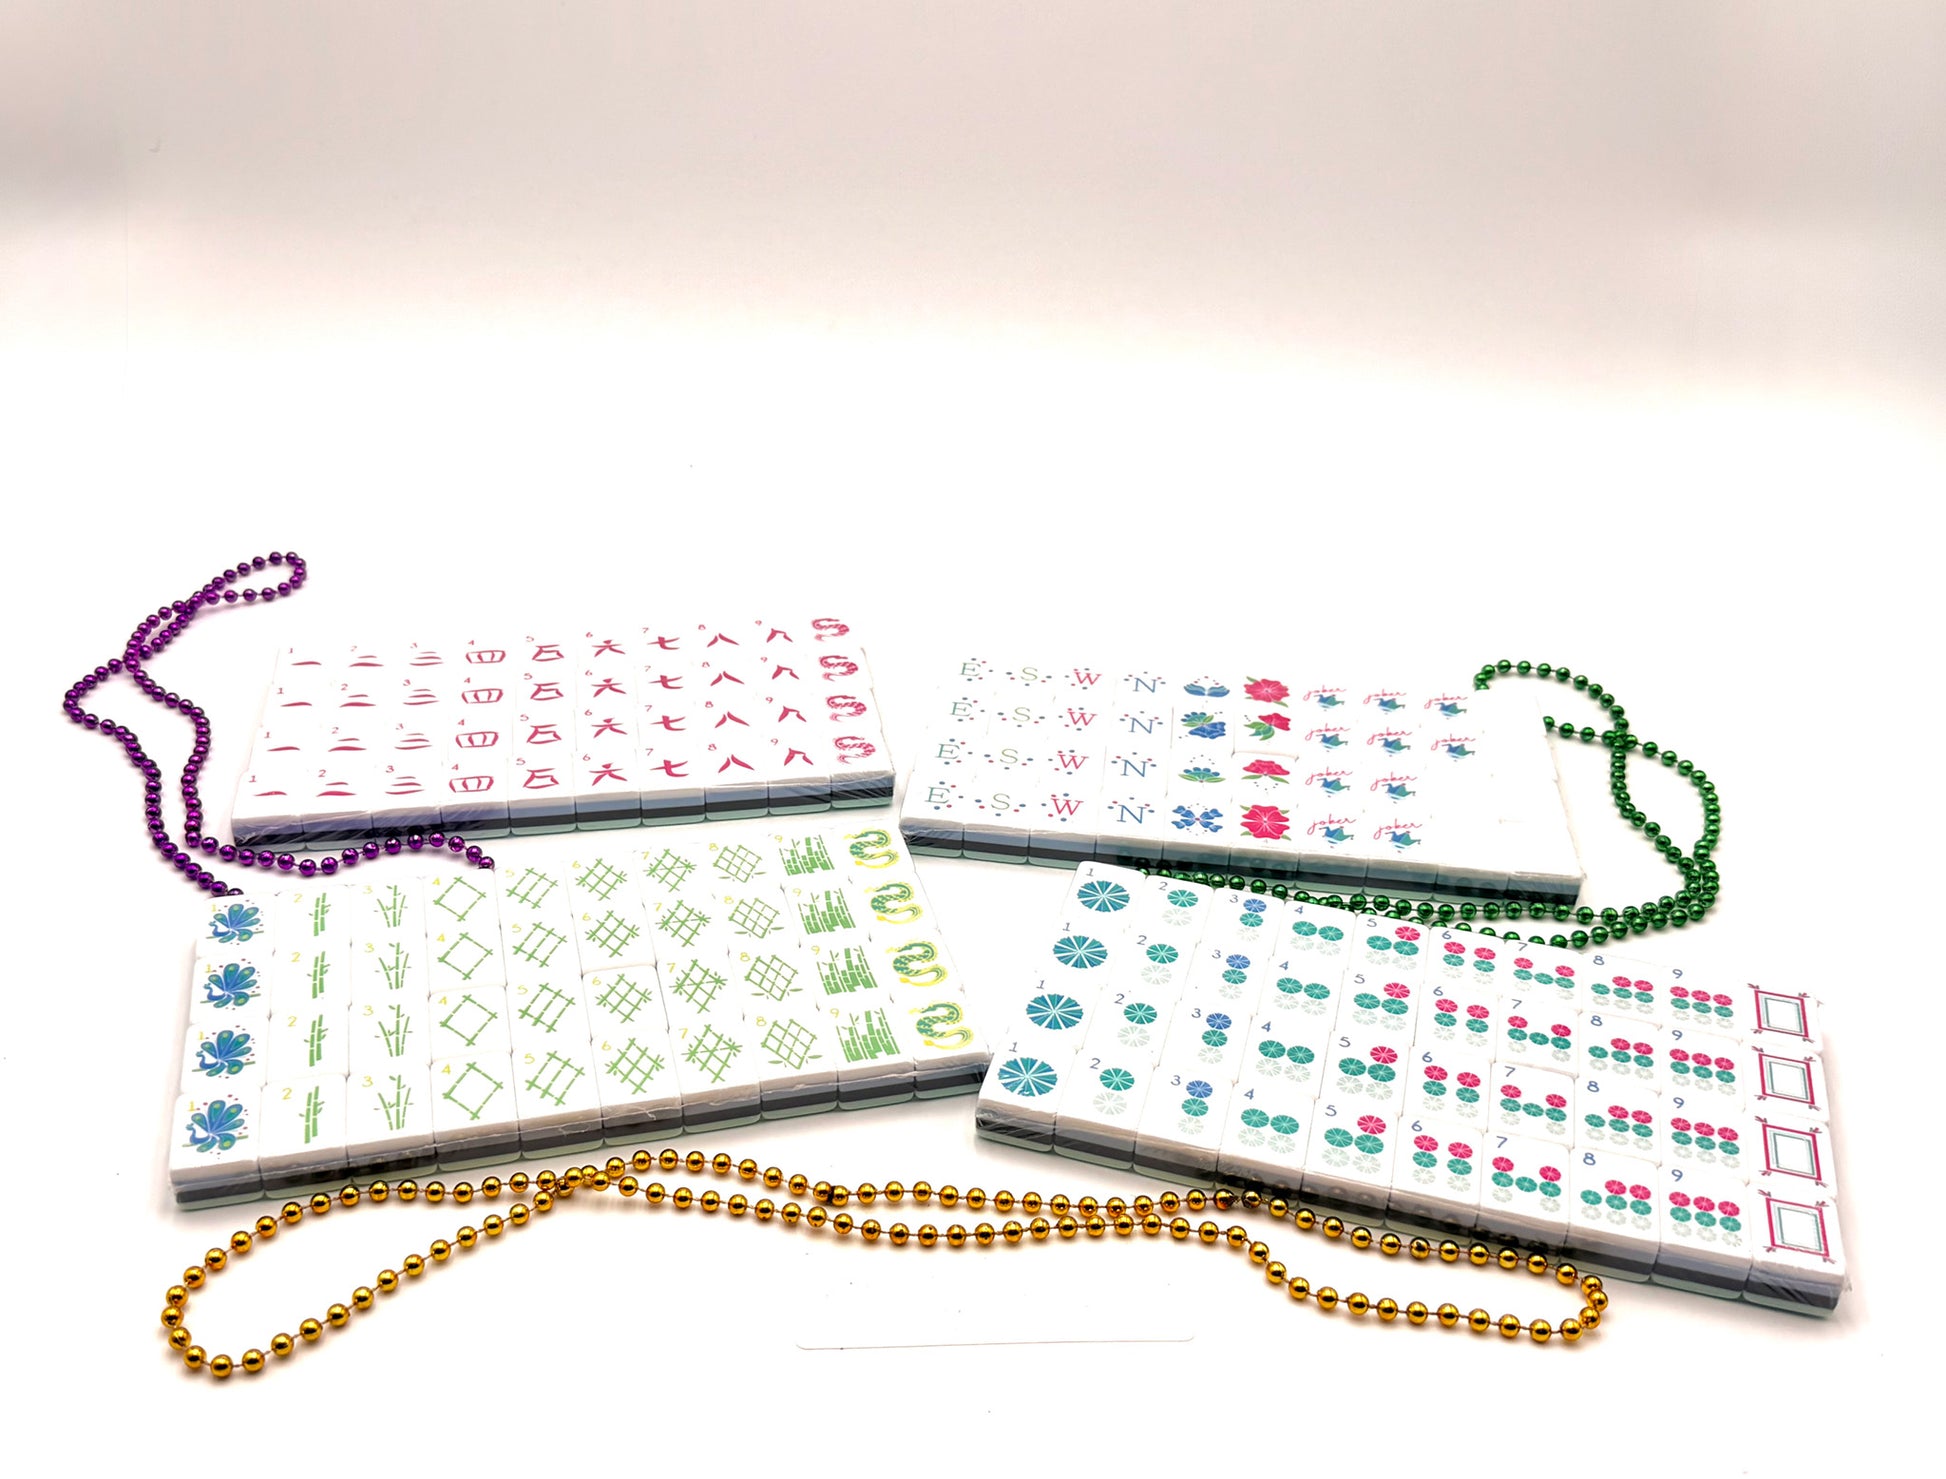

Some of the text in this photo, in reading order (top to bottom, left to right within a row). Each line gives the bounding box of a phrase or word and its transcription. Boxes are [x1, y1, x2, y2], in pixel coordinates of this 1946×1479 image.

[409, 651, 444, 666] 三
[960, 662, 982, 677] E
[1020, 666, 1038, 682] S
[1073, 670, 1102, 686] W
[1132, 677, 1158, 694] N
[403, 688, 439, 705] 三
[1302, 685, 1347, 701] joker
[1363, 689, 1406, 704] joker
[1424, 693, 1467, 709] joker
[950, 702, 974, 717] E
[1012, 706, 1032, 722] S
[1067, 712, 1098, 726] W
[1128, 717, 1156, 734] N
[1305, 723, 1350, 741] joker
[1366, 727, 1412, 744] joker
[394, 733, 432, 750] 三
[1430, 734, 1475, 751] joker
[936, 743, 962, 760] E
[1000, 748, 1018, 764] S
[1057, 754, 1089, 770] W
[1120, 759, 1149, 778] N
[1305, 767, 1352, 785] joker
[1370, 773, 1417, 791] joker
[385, 776, 425, 795] 三
[927, 786, 951, 804] E
[990, 793, 1010, 810] S
[1050, 798, 1084, 816] W
[1116, 804, 1147, 824] N
[1307, 814, 1356, 835] joker
[1373, 818, 1422, 840] joker
[1086, 868, 1093, 877] 1
[791, 887, 803, 897] 9
[1159, 882, 1168, 891] 2
[723, 895, 735, 905] 8
[1230, 895, 1238, 903] 3
[654, 901, 663, 913] 7
[1294, 906, 1303, 914] 4
[581, 912, 592, 922] 6
[1367, 919, 1377, 927] 5
[511, 922, 523, 934] 5
[1062, 923, 1070, 931] 1
[436, 933, 446, 943] 4
[1137, 935, 1147, 945] 2
[1442, 931, 1451, 939] 6
[364, 942, 375, 954] 3
[810, 944, 821, 956] 9
[1519, 942, 1527, 951] 7
[290, 951, 302, 964] 2
[739, 951, 752, 963] 8
[1212, 950, 1221, 959] 3
[1593, 955, 1604, 965] 8
[205, 964, 212, 973] 1
[666, 961, 677, 974] 7
[1279, 961, 1288, 970] 4
[1354, 974, 1365, 984] 5
[1672, 969, 1683, 979] 9
[591, 975, 602, 986] 6
[1036, 980, 1044, 989] 1
[516, 984, 529, 996] 5
[1433, 986, 1443, 996] 6
[438, 995, 448, 1006] 4
[1114, 993, 1124, 1004] 2
[1512, 999, 1522, 1009] 7
[362, 1004, 375, 1017] 3
[829, 1007, 840, 1019] 9
[1192, 1008, 1201, 1018] 3
[287, 1015, 298, 1028] 2
[755, 1015, 768, 1027] 8
[1591, 1015, 1603, 1026] 8
[1261, 1022, 1271, 1032] 4
[198, 1031, 205, 1041] 1
[678, 1027, 689, 1040] 7
[1672, 1030, 1683, 1040] 9
[600, 1040, 613, 1052] 6
[1009, 1042, 1017, 1052] 1
[1339, 1037, 1351, 1047] 5
[523, 1052, 536, 1065] 5
[1090, 1058, 1101, 1069] 2
[1422, 1052, 1432, 1063] 6
[441, 1063, 452, 1075] 4
[1505, 1066, 1515, 1077] 7
[361, 1075, 374, 1088] 3
[1171, 1075, 1181, 1086] 3
[1587, 1081, 1599, 1092] 8
[281, 1087, 293, 1101] 2
[1244, 1089, 1254, 1100] 4
[188, 1101, 197, 1112] 1
[1673, 1097, 1684, 1108] 9
[1325, 1105, 1337, 1116] 5
[1411, 1120, 1422, 1132] 6
[1497, 1136, 1507, 1148] 7
[1583, 1153, 1596, 1165] 8
[1672, 1169, 1683, 1182] 9
